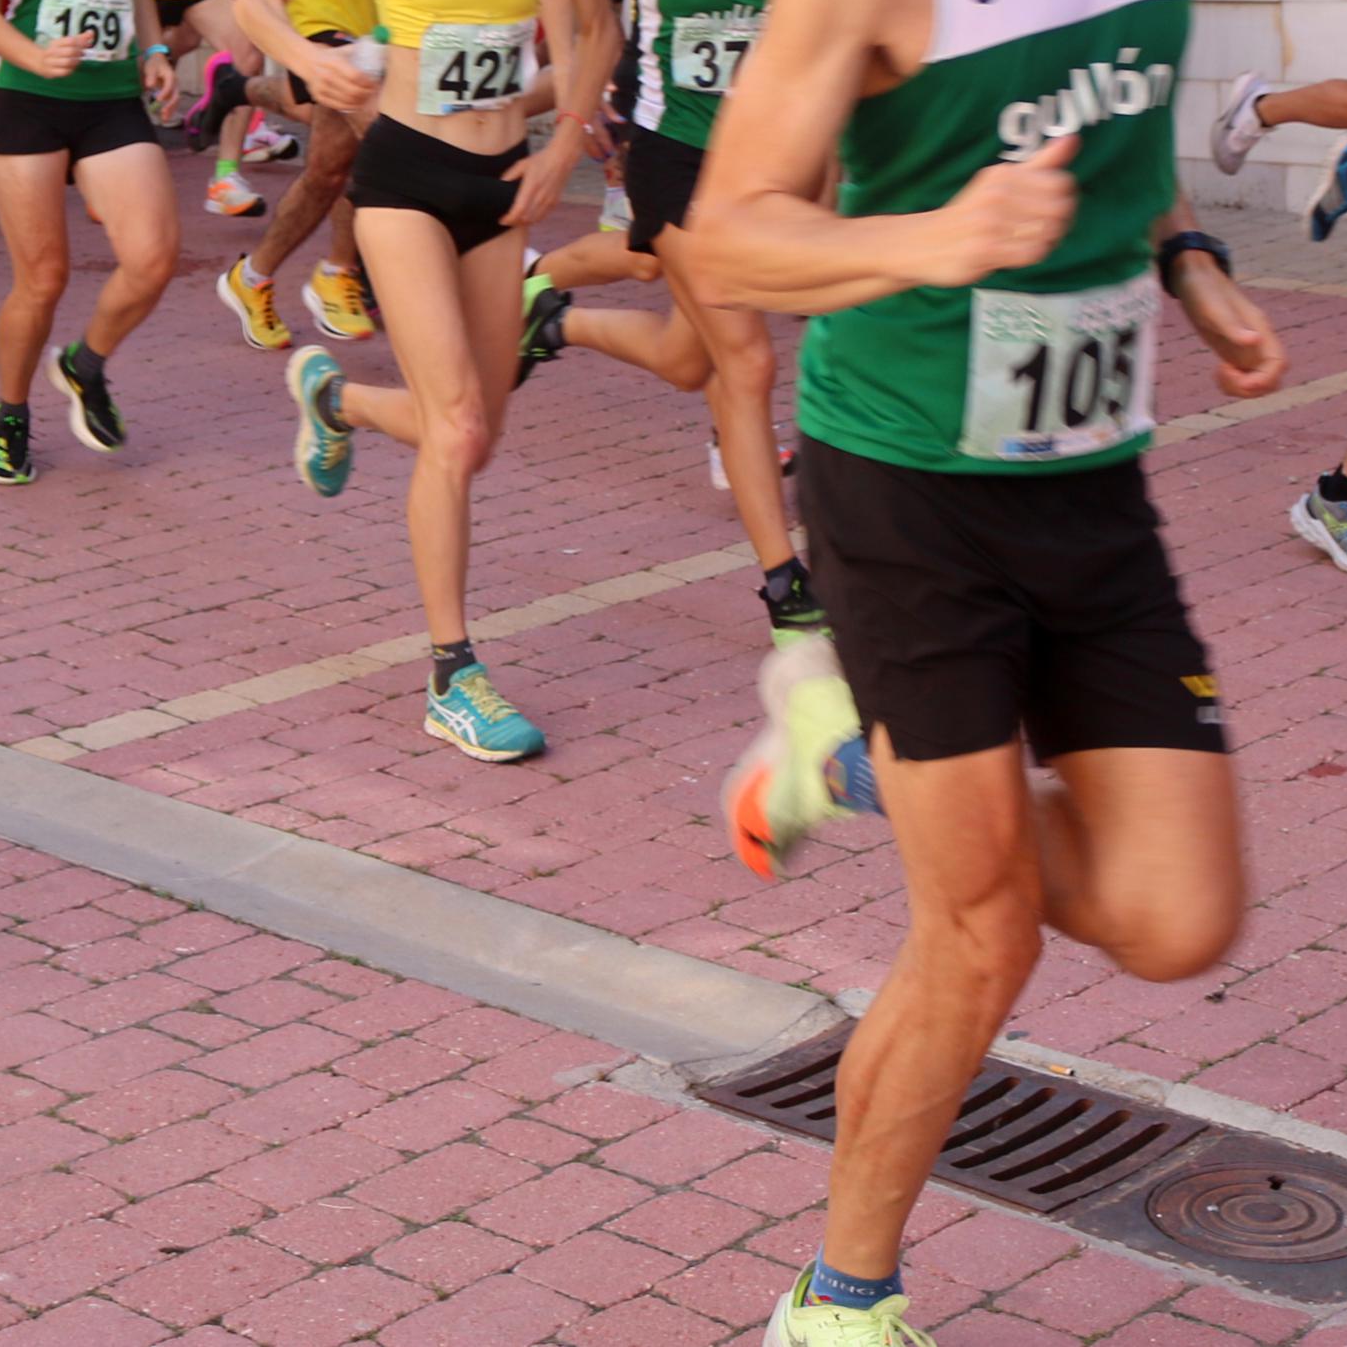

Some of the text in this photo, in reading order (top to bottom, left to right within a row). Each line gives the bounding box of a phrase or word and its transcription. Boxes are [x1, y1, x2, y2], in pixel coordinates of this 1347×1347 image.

[54, 8, 120, 50] 169
[438, 46, 521, 100] 422
[998, 47, 1174, 162] gullón
[1012, 329, 1136, 431] 105
